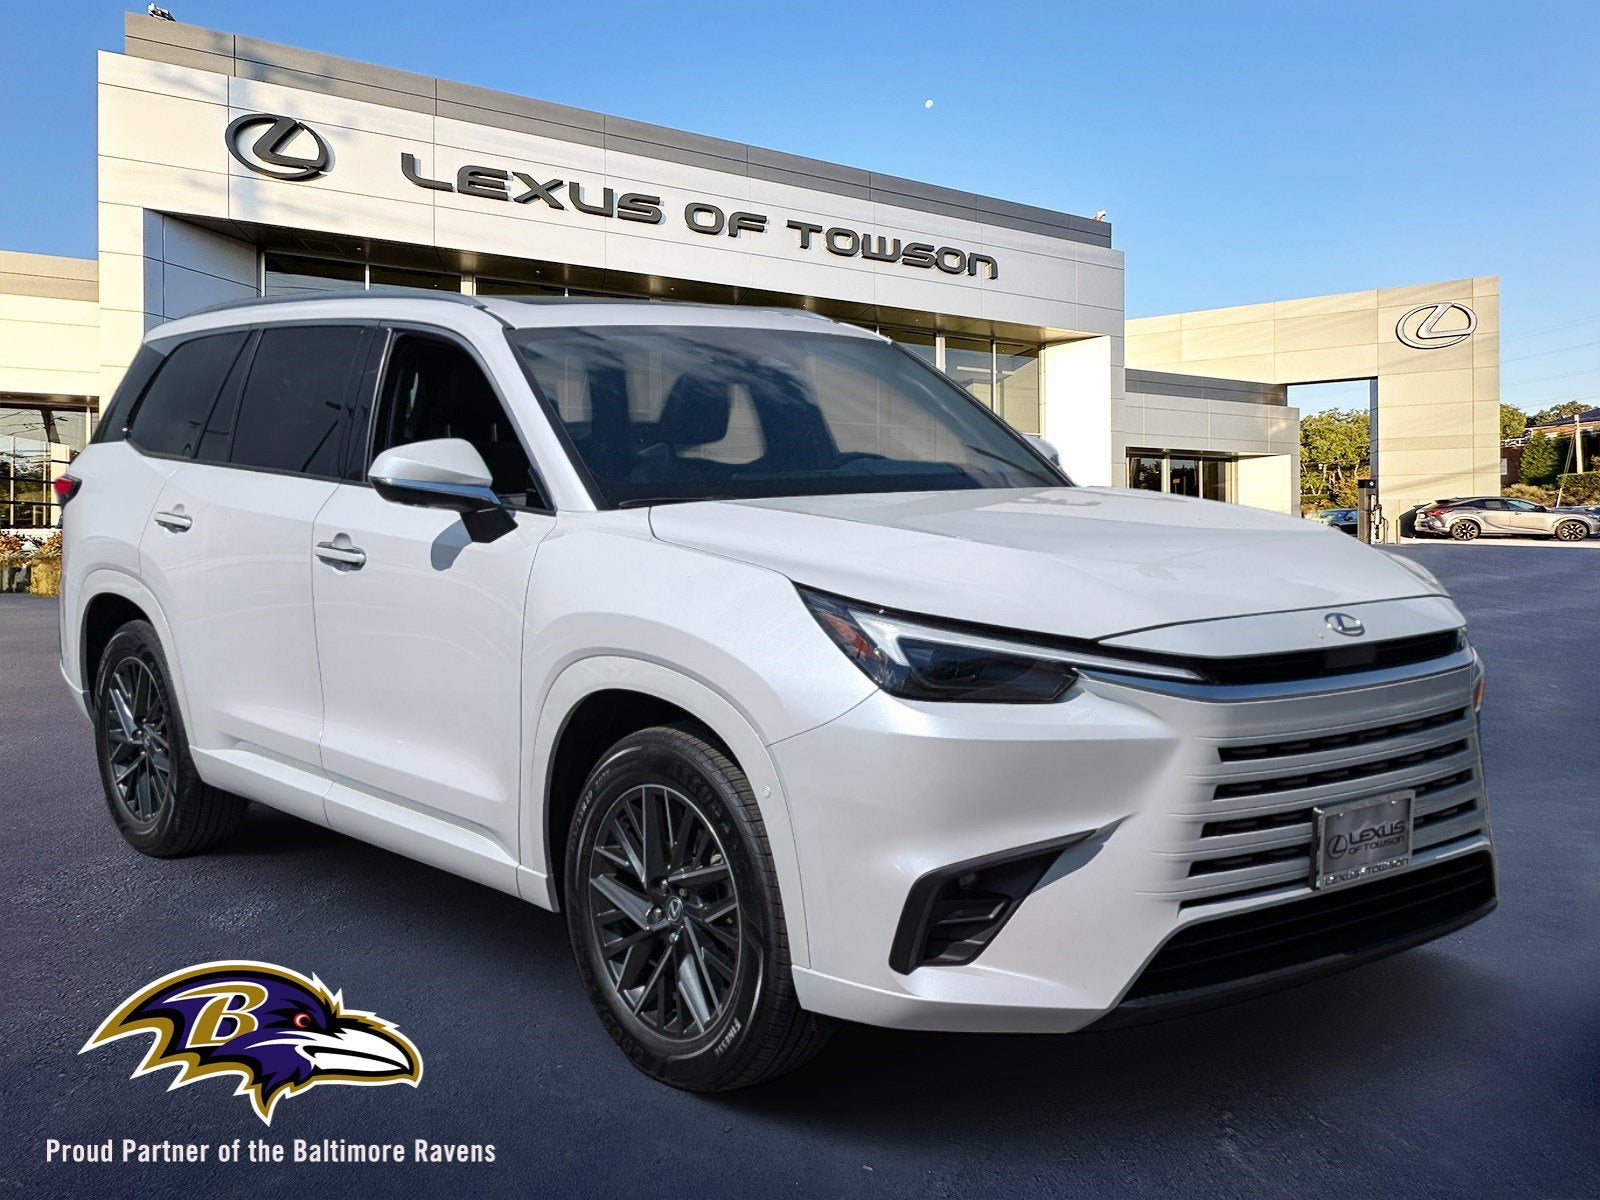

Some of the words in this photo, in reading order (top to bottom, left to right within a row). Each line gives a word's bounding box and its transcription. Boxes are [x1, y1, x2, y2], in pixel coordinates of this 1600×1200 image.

[401, 152, 664, 224] LEXUS
[684, 202, 768, 237] OF
[786, 219, 998, 280] TOWSON
[1348, 821, 1405, 844] LEXUS
[1348, 845, 1361, 855] OF
[1363, 835, 1405, 851] TOWSON
